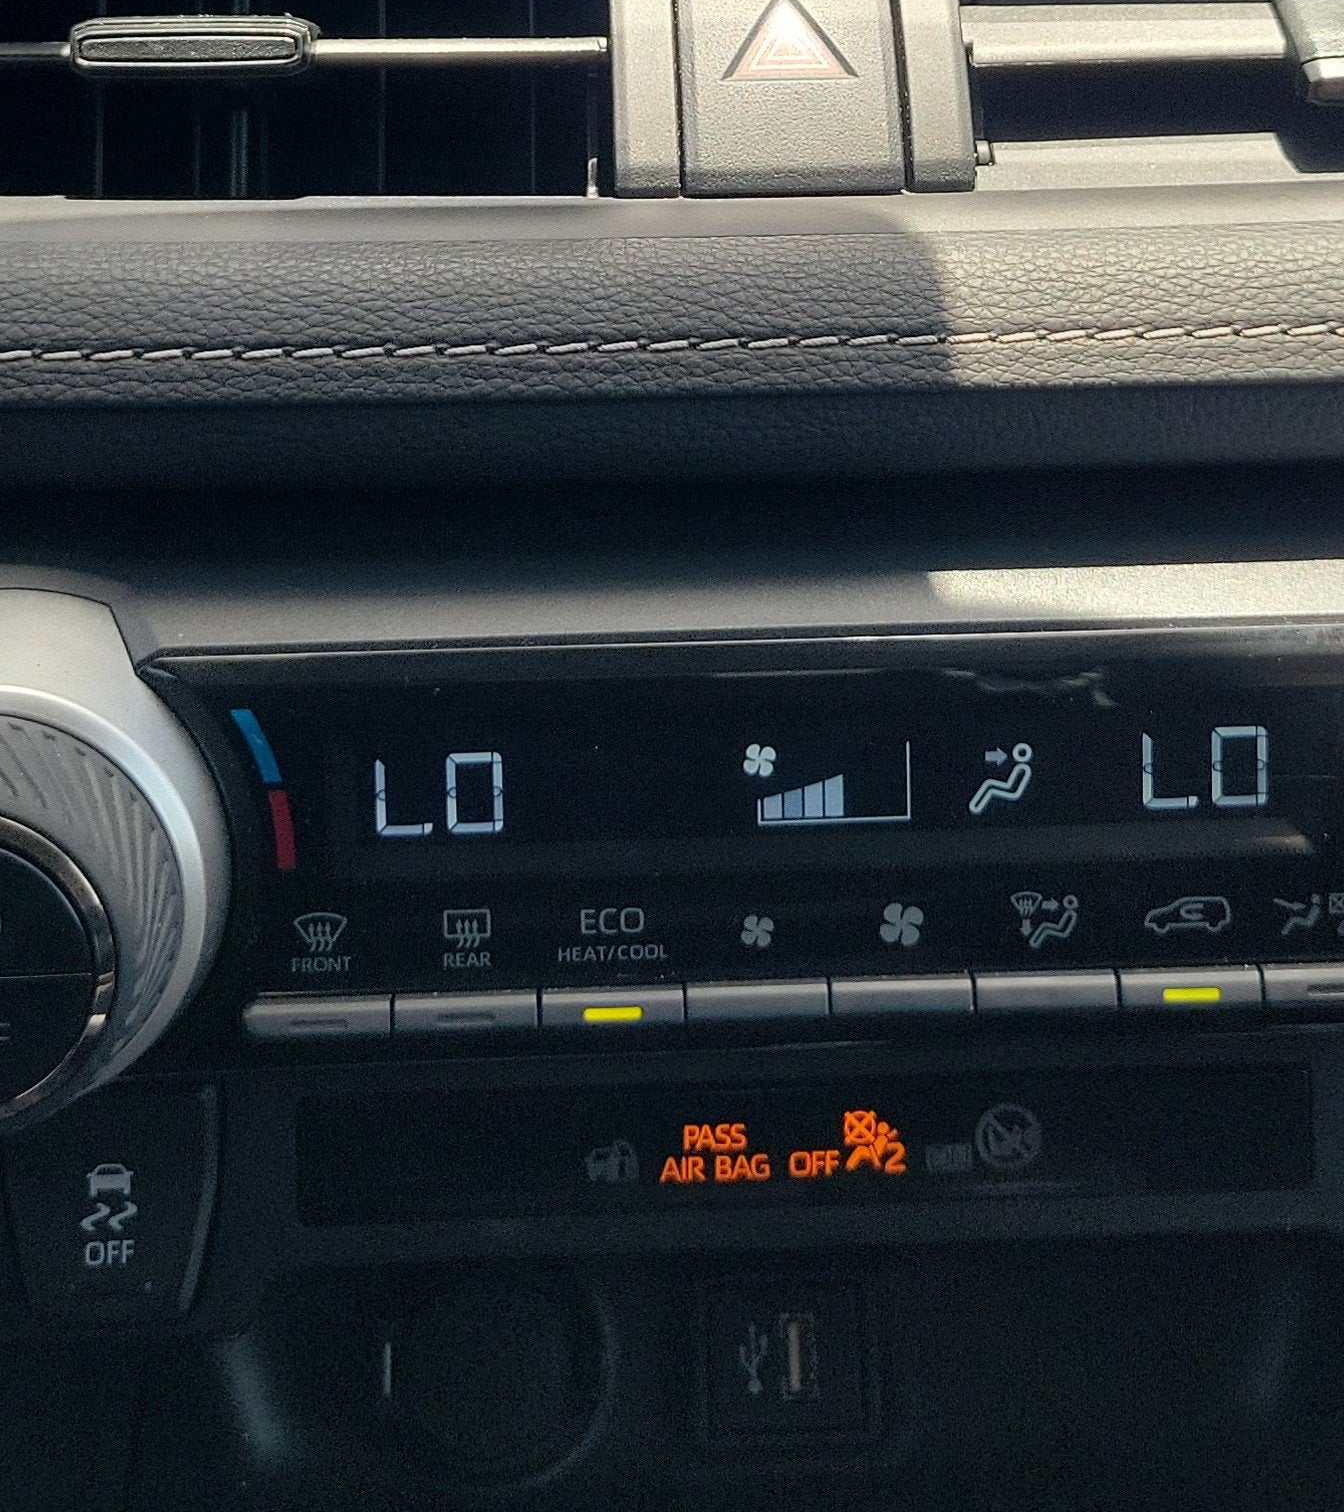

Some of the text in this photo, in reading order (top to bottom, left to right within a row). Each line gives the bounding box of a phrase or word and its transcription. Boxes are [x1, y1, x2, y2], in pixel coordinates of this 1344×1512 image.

[1141, 725, 1269, 811] LO
[373, 751, 504, 837] LO
[580, 907, 645, 936] ECO
[291, 955, 352, 974] FRONT
[442, 950, 492, 968] REAR
[557, 944, 669, 963] HEAT/COOL
[682, 1123, 747, 1152] PASS
[659, 1150, 840, 1184] AIR BAG OFF
[84, 1240, 136, 1267] OFF
